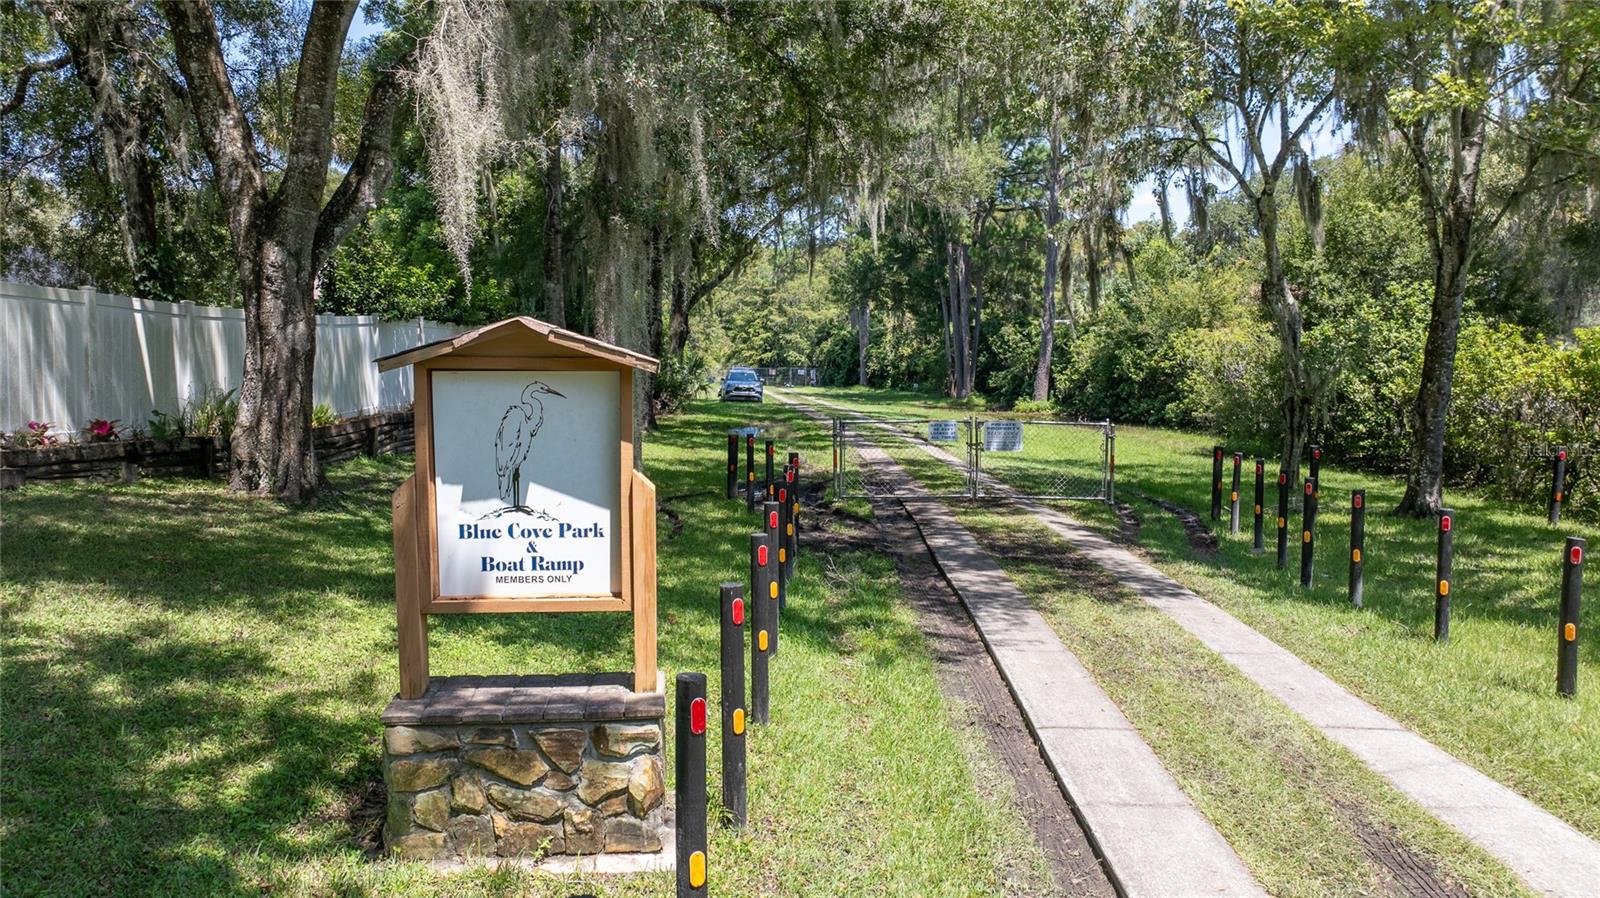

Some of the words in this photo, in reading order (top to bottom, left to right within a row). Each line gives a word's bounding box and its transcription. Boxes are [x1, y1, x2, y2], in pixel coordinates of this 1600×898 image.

[459, 524, 502, 539] Blue
[508, 523, 553, 539] Cove
[559, 523, 604, 538] Park
[526, 541, 538, 553] &
[481, 557, 526, 572] Boat
[532, 556, 584, 574] Ramp
[547, 575, 572, 583] ONLY
